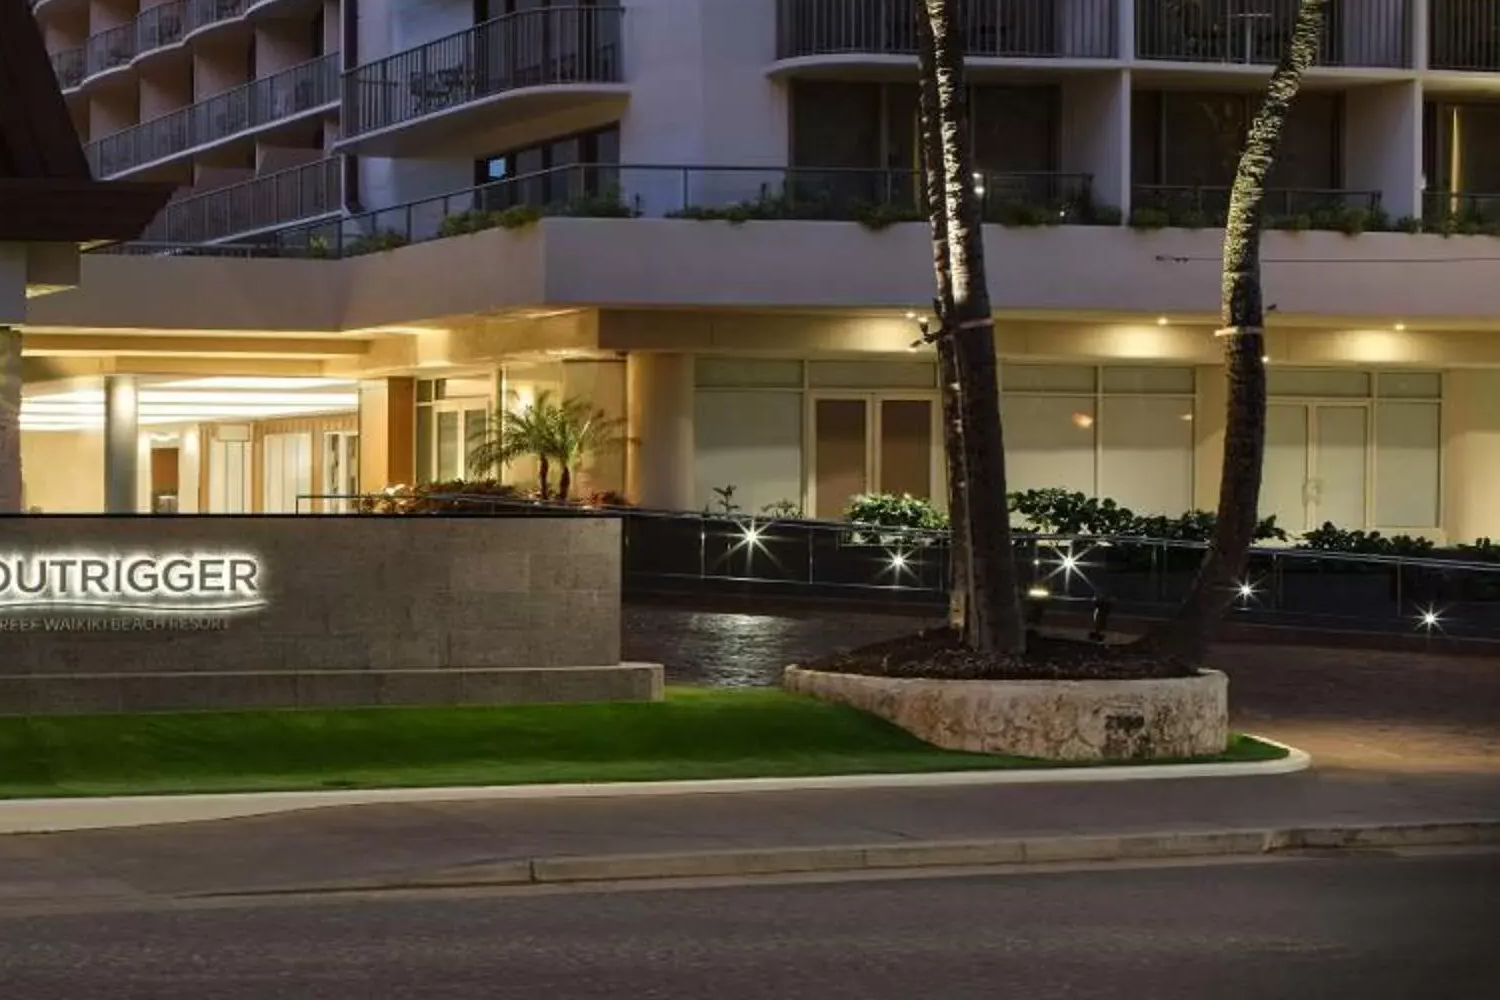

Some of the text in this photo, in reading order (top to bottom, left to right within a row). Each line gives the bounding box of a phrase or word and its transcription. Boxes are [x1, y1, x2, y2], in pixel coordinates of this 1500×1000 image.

[0, 617, 229, 632] REEF WAIKIKI BEACH RESORT
